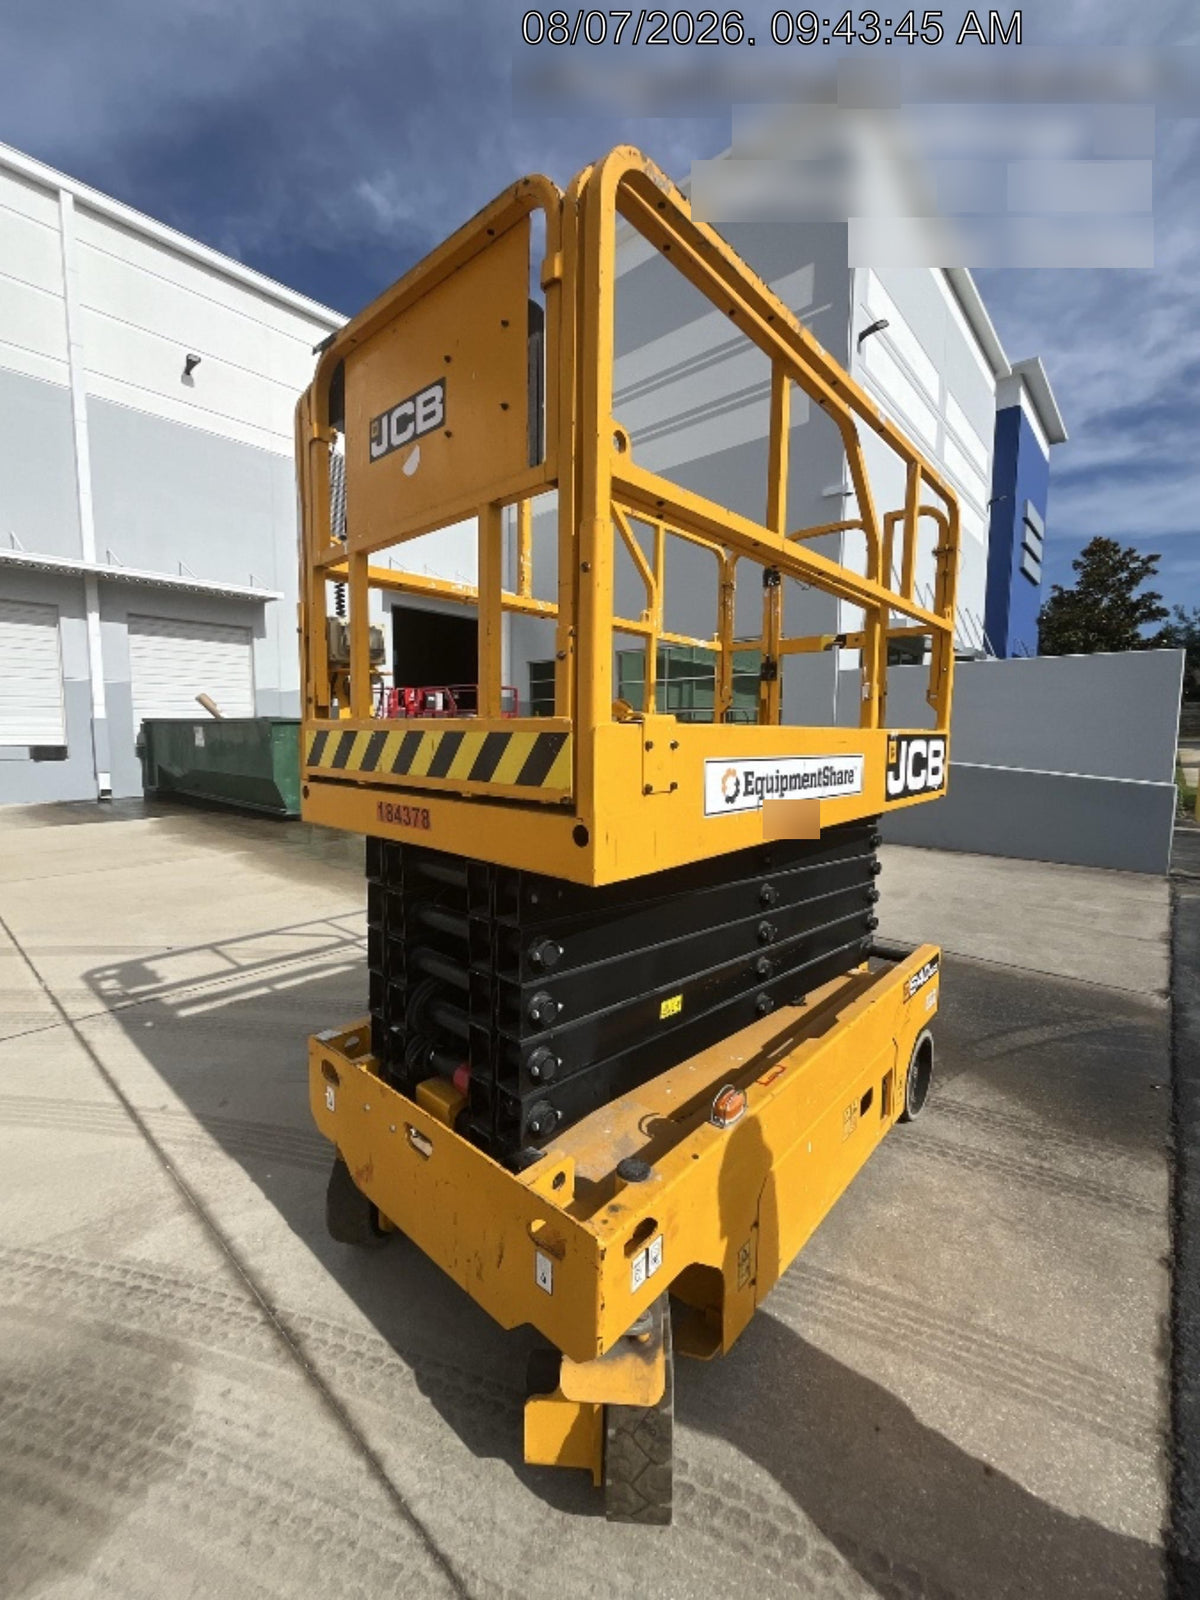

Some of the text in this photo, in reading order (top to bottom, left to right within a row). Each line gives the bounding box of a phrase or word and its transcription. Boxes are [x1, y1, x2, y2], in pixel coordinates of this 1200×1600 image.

[371, 385, 443, 458] JCB
[743, 765, 854, 800] EquipmentShare
[887, 739, 945, 795] JCB
[377, 801, 431, 830] 184378
